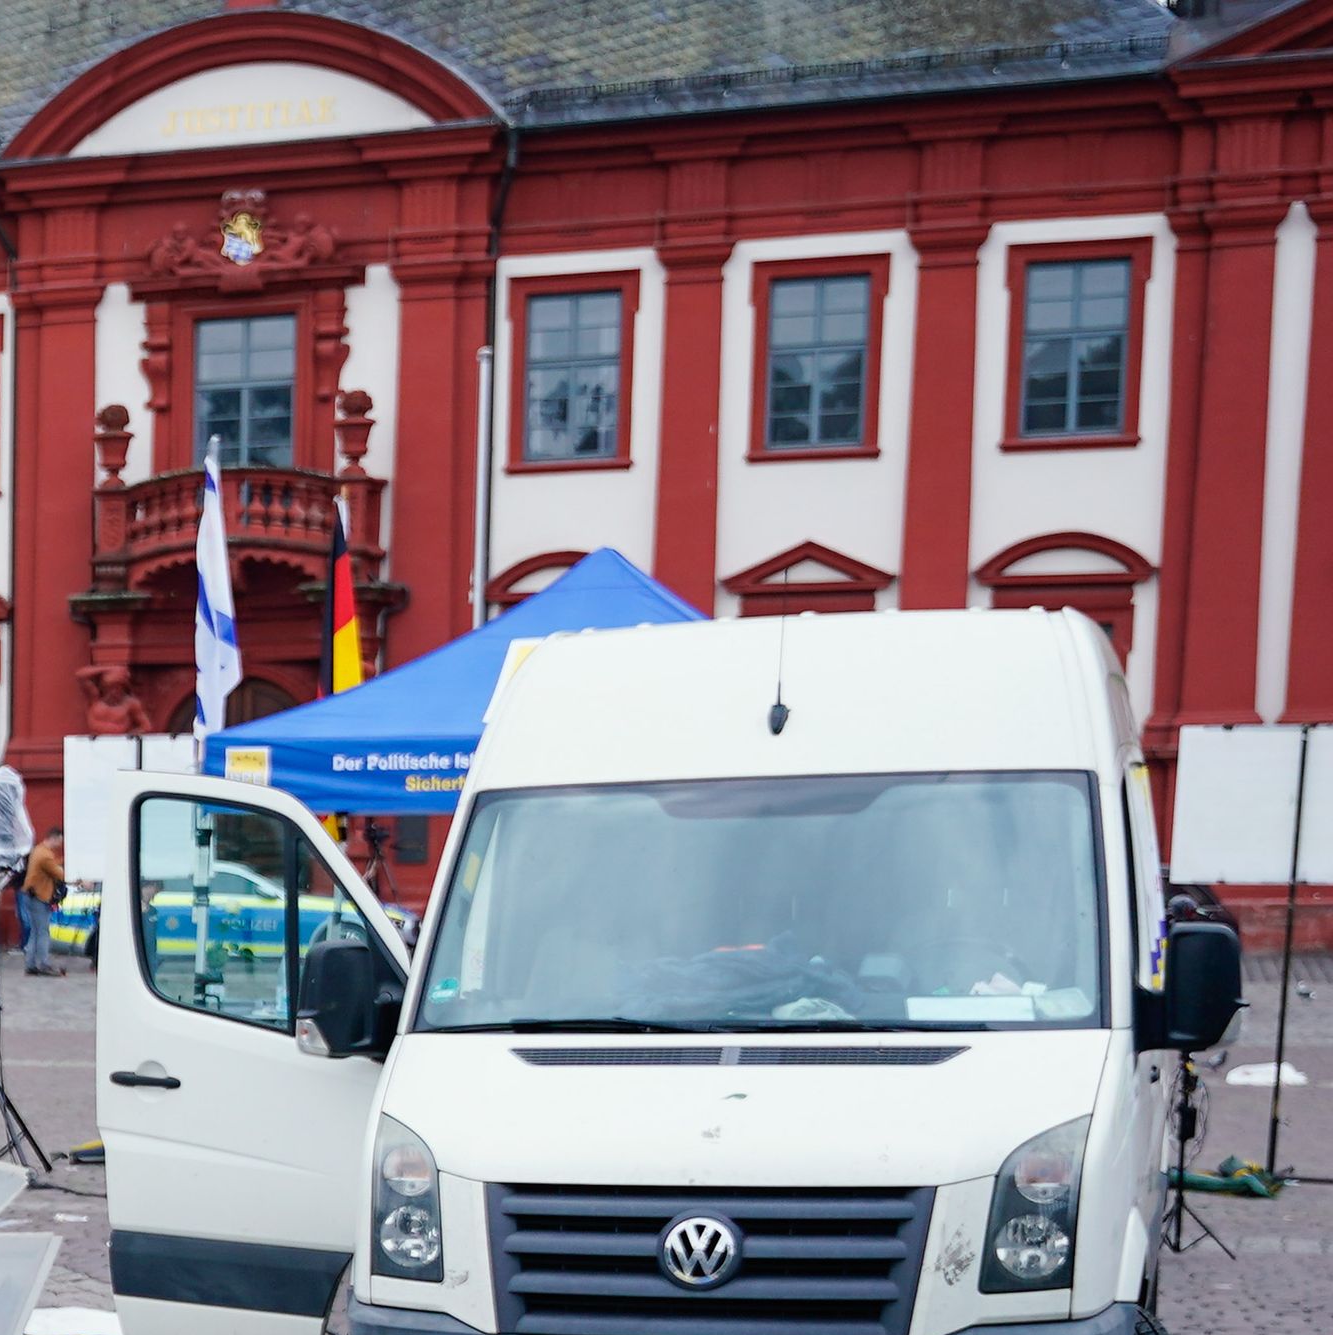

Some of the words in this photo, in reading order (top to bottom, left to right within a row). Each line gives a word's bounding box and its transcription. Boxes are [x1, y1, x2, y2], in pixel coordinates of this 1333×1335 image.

[161, 97, 338, 136] JUSTITIAE
[332, 754, 363, 771] Der
[367, 752, 451, 770] Politische
